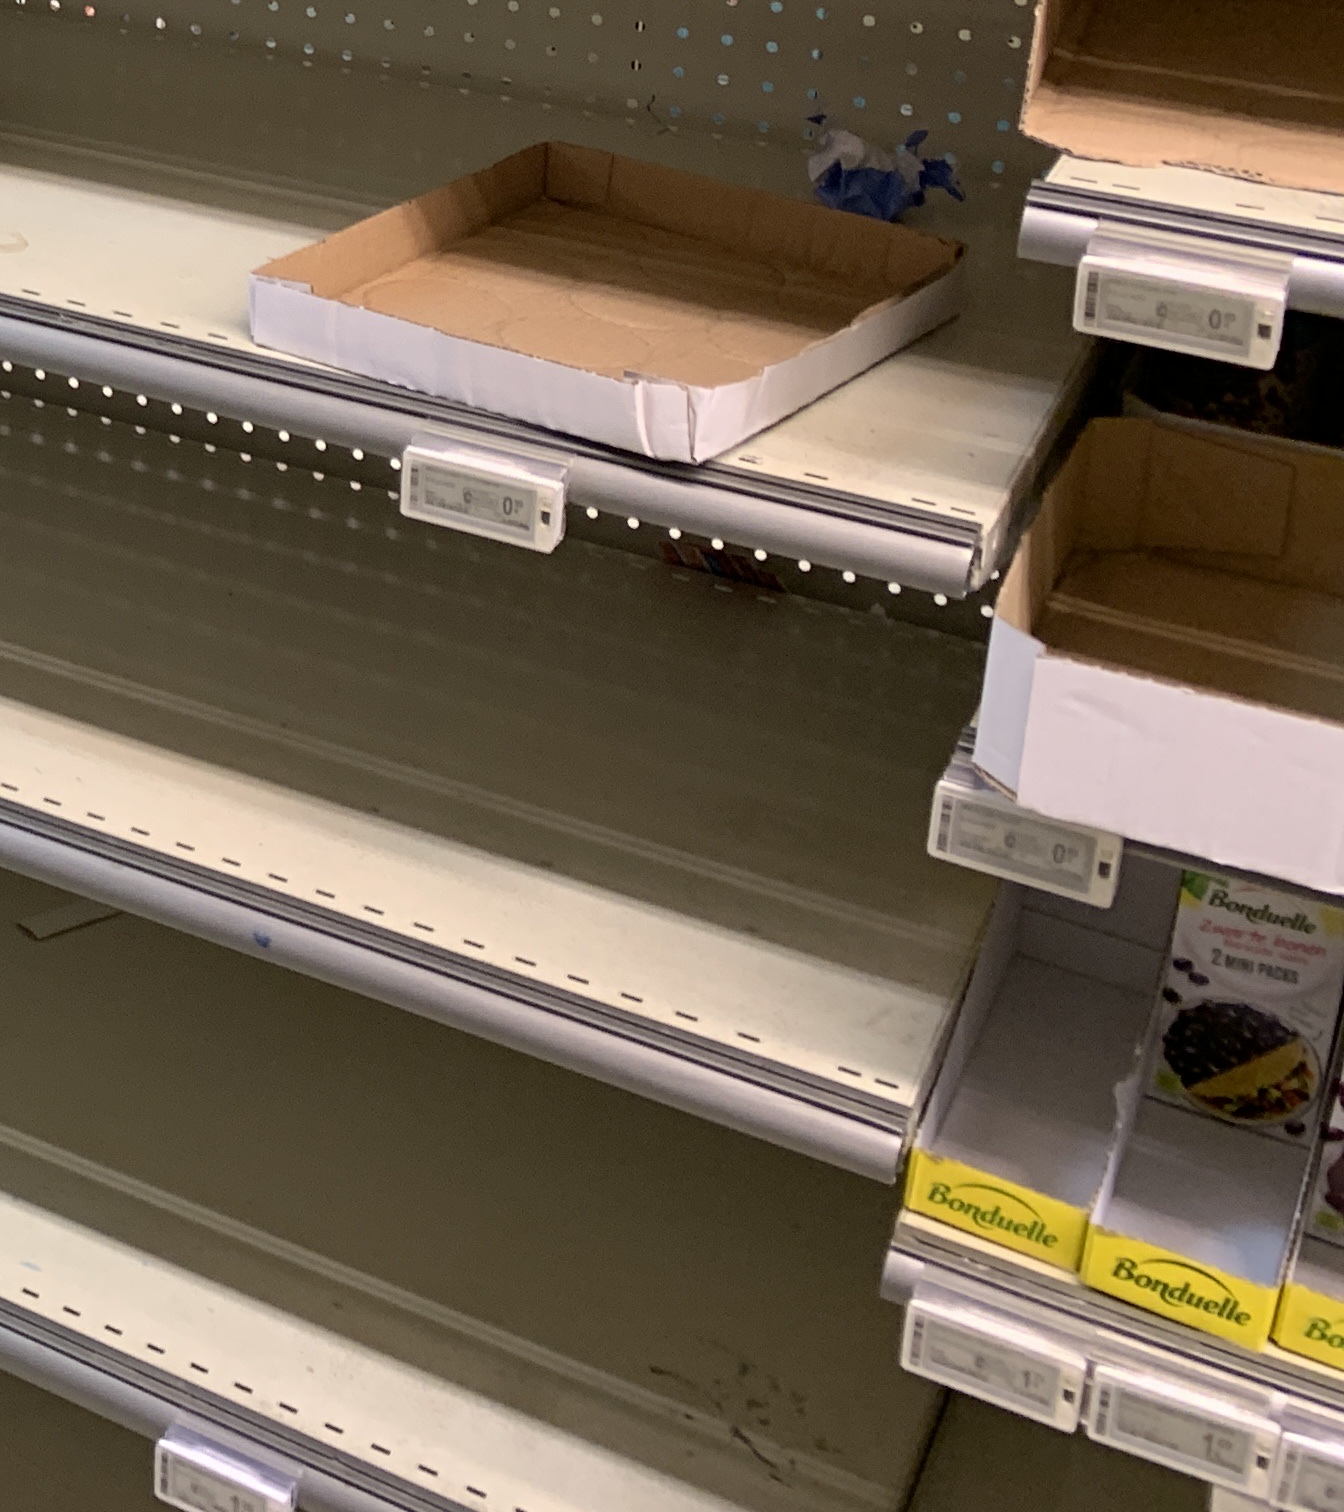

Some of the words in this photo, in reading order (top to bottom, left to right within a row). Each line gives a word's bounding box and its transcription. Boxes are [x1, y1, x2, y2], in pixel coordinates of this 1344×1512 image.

[1208, 889, 1317, 935] Bonduelle
[927, 1181, 1059, 1248] Bonduelle
[1110, 1256, 1253, 1328] Bonduelle
